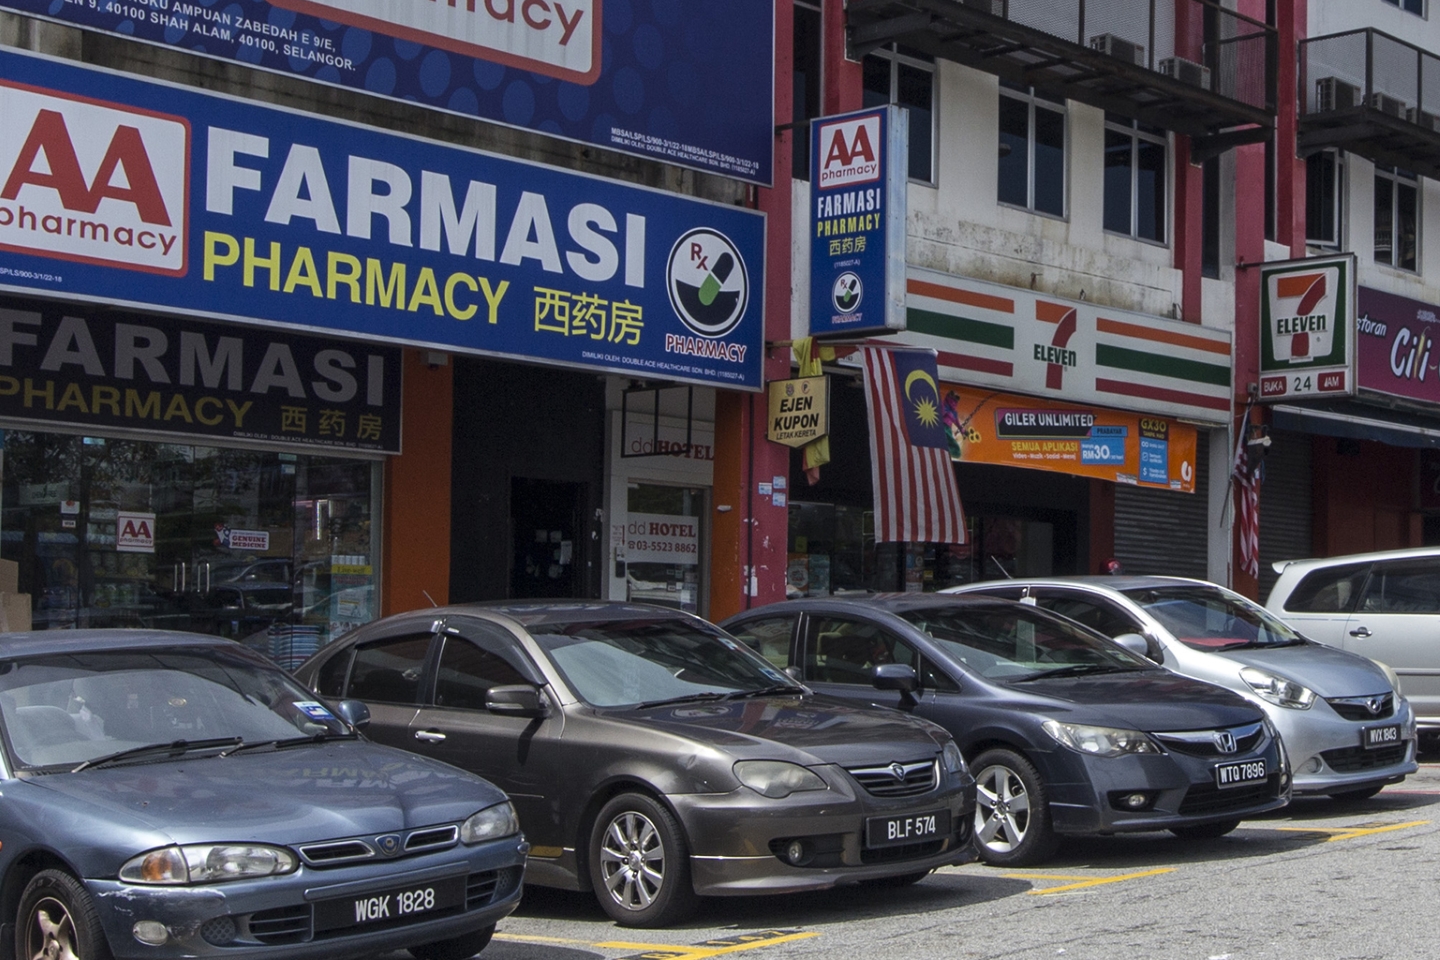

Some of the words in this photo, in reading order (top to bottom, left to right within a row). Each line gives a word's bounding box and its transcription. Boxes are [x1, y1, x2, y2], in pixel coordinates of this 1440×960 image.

[106, 2, 146, 21] 40100
[150, 12, 189, 32] SHAH
[193, 22, 235, 43] ALAM,
[239, 33, 279, 54] 40100,
[283, 45, 356, 71] SELANGOR.
[173, 1, 231, 25] AMPUAN
[235, 16, 298, 42] ZABEDAH
[302, 33, 310, 44] E
[314, 35, 336, 52] 9/E,
[824, 124, 876, 170] AA
[1, 108, 172, 228] AA
[821, 162, 878, 183] pharmacy
[206, 126, 646, 288] FARMASI
[817, 188, 881, 219] FARMASI
[817, 213, 881, 237] PHARMACY
[829, 235, 867, 256] 西药房
[204, 231, 510, 325] PHARMACY
[533, 286, 645, 346] 西药房
[1357, 315, 1387, 337] storan
[0, 308, 384, 407] FARMASI
[665, 333, 747, 363] PHARMACY
[622, 356, 645, 367] DOUBLE
[645, 359, 656, 368] ACE
[657, 361, 691, 373] HEALTHCARE
[1263, 379, 1284, 393] BUKA
[1294, 375, 1312, 392] 24
[1324, 375, 1340, 389] JAM
[0, 375, 254, 428] PHARMACY
[779, 396, 813, 413] EJEN
[280, 405, 384, 441] 西药房
[773, 413, 819, 431] KUPON
[1005, 413, 1036, 426] GILER
[1038, 414, 1094, 427] UNLIMITED
[1141, 418, 1167, 432] GX30
[776, 430, 794, 440] LETAK
[795, 429, 816, 439] KERETA
[656, 441, 714, 461] HOTEL
[1011, 442, 1040, 451] SEMUA
[1042, 442, 1078, 452] APLIKASI
[121, 520, 152, 539] AA
[628, 520, 646, 536] dd
[649, 522, 696, 538] HOTEL
[637, 542, 673, 553] 03-5523
[674, 542, 697, 554] 8862
[1220, 767, 1240, 783] WTQ
[1241, 762, 1265, 781] 7896
[888, 819, 913, 840] BLF
[914, 815, 936, 836] 574
[355, 895, 390, 922] WGK
[396, 888, 435, 915] 1828
